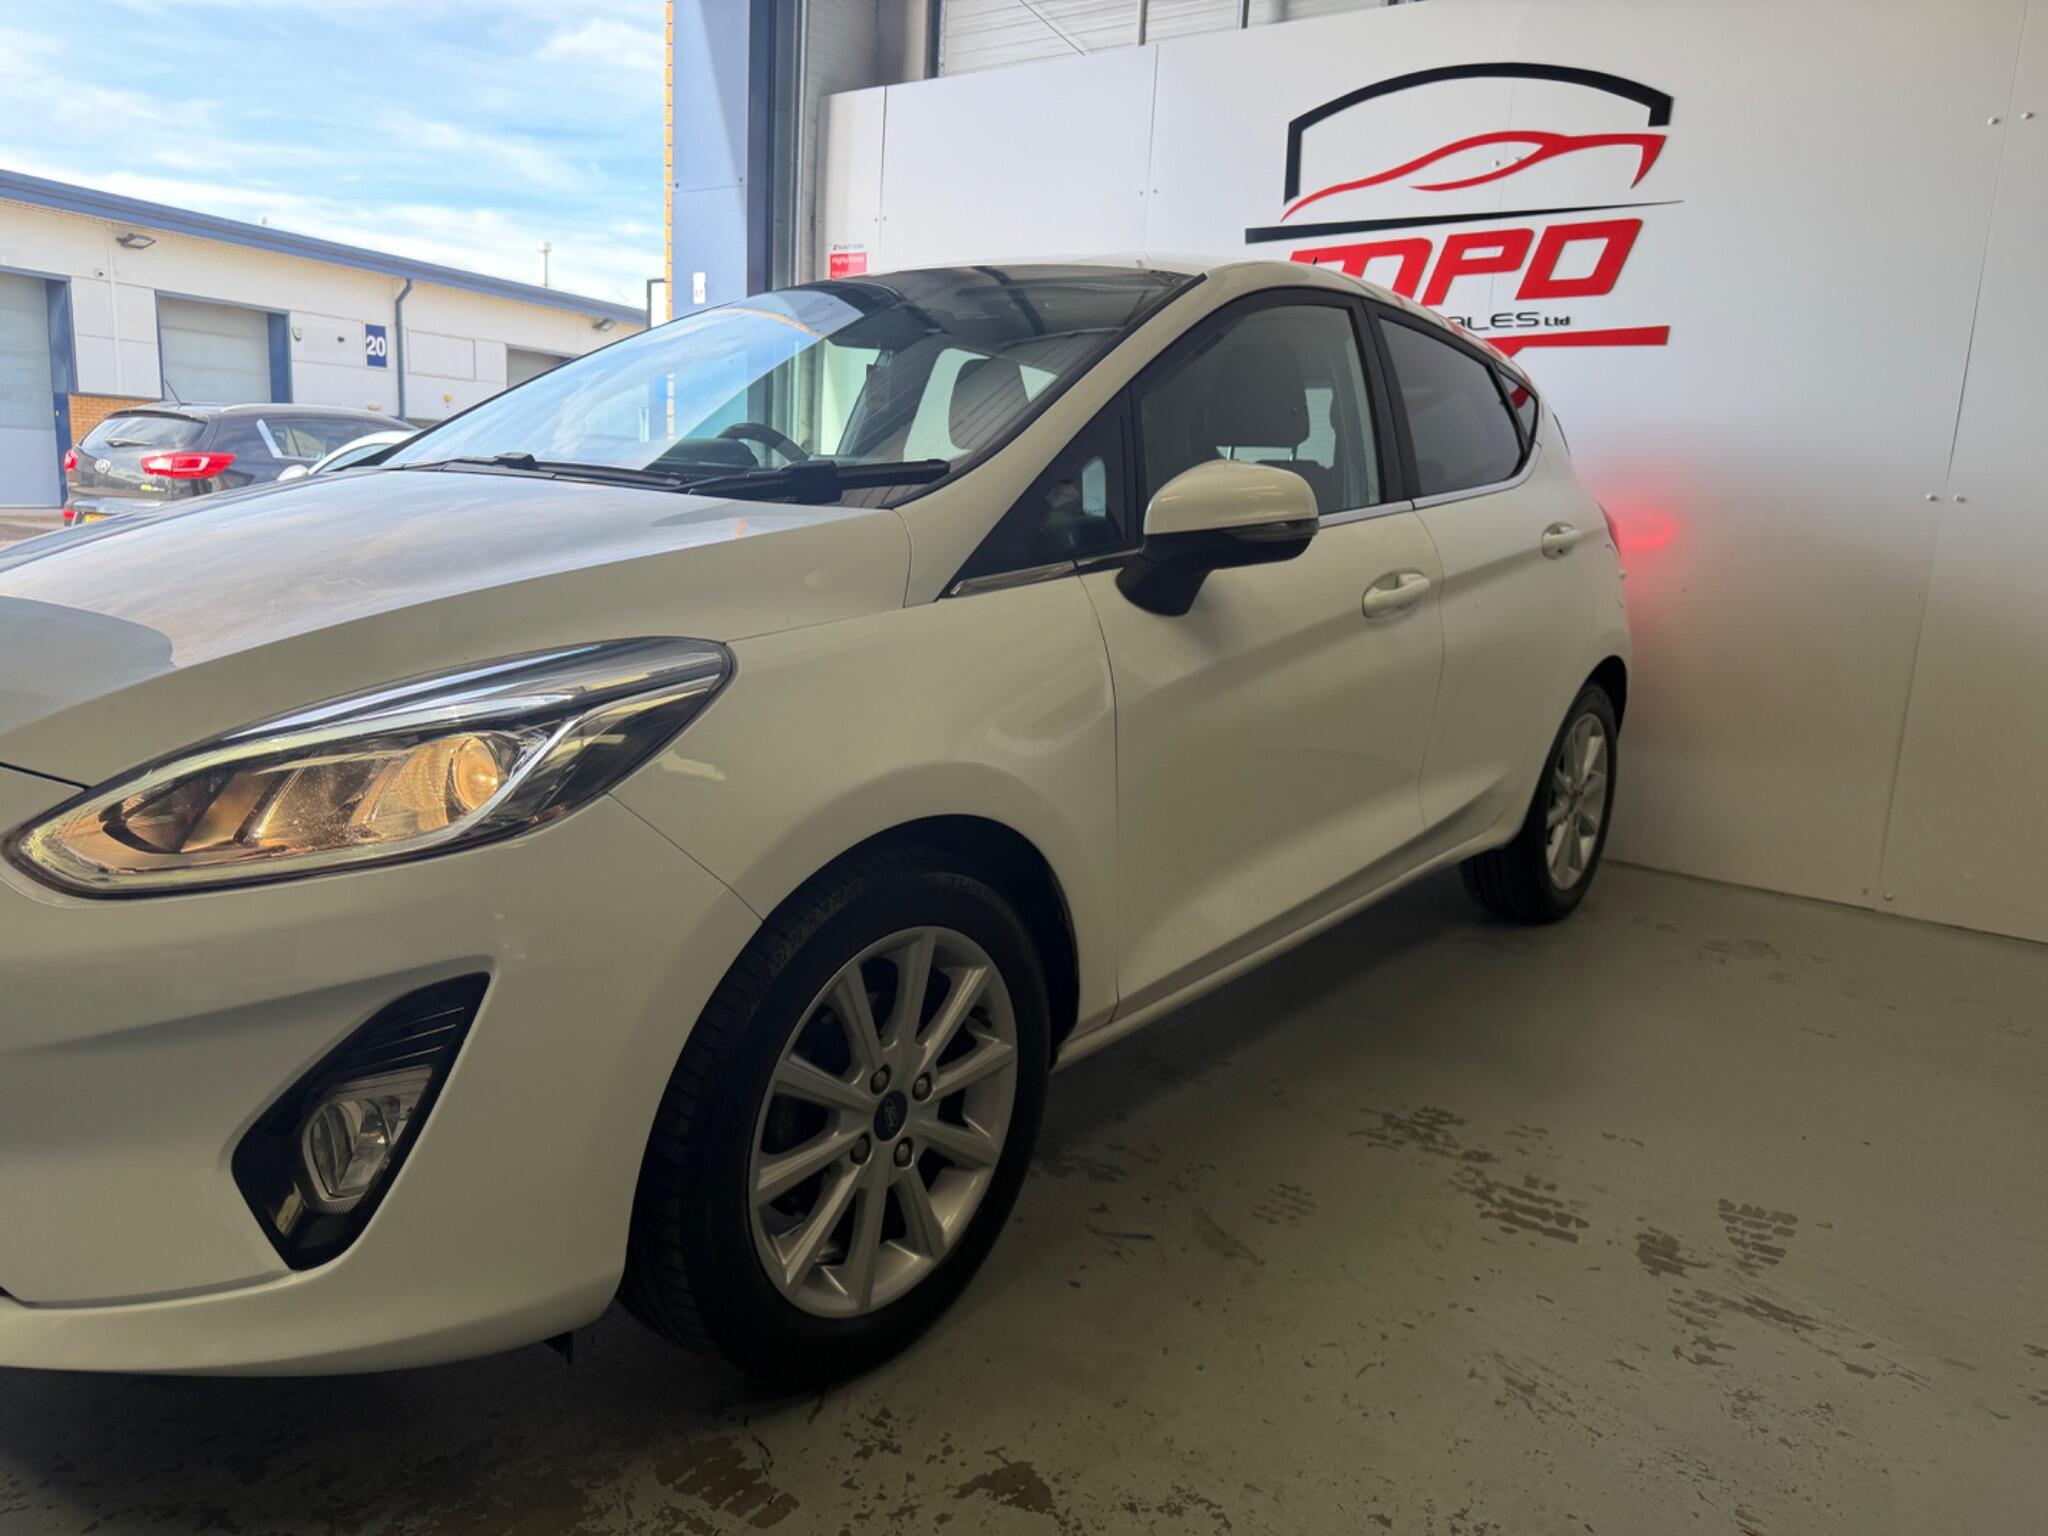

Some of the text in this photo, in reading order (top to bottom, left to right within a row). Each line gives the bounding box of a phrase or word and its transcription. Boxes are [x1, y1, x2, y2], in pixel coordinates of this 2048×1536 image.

[1448, 312, 1570, 331] ALES Ltd
[366, 335, 386, 357] 20
